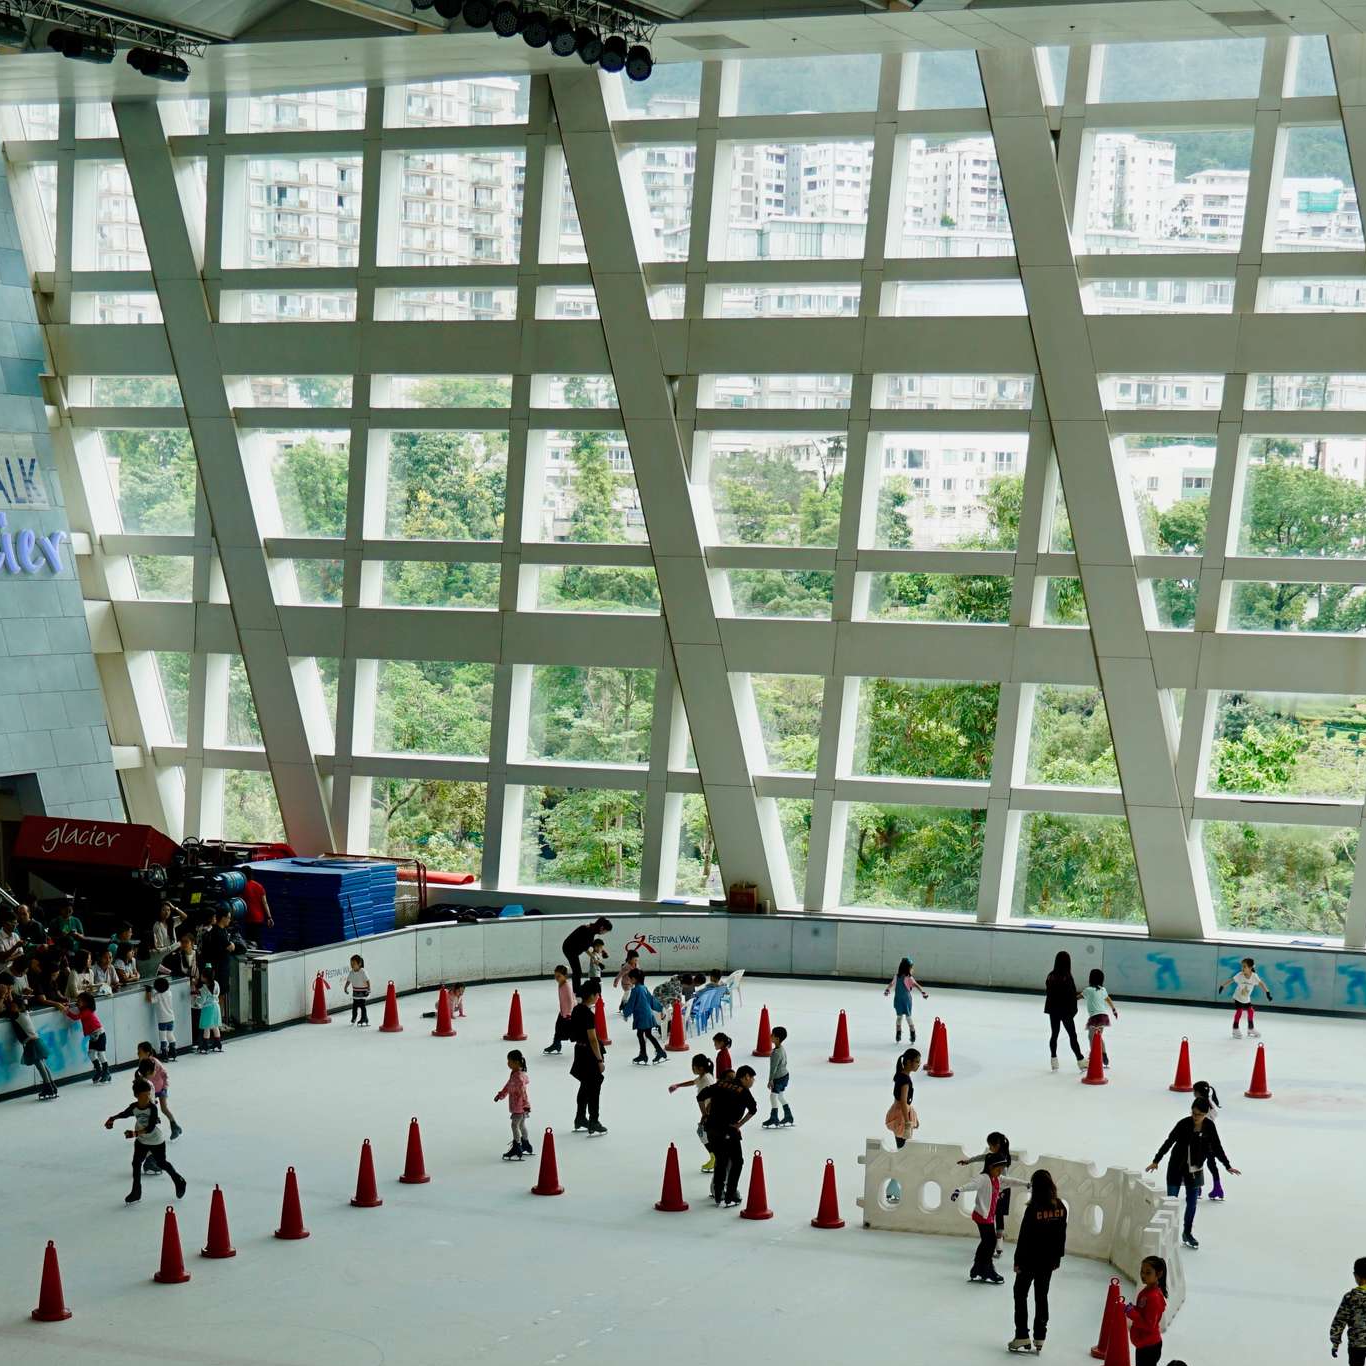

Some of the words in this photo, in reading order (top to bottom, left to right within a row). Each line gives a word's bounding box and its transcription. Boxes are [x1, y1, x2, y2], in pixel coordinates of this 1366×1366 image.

[41, 822, 122, 853] glacier
[648, 934, 678, 944] FESTIVAL
[679, 935, 701, 944] WALK
